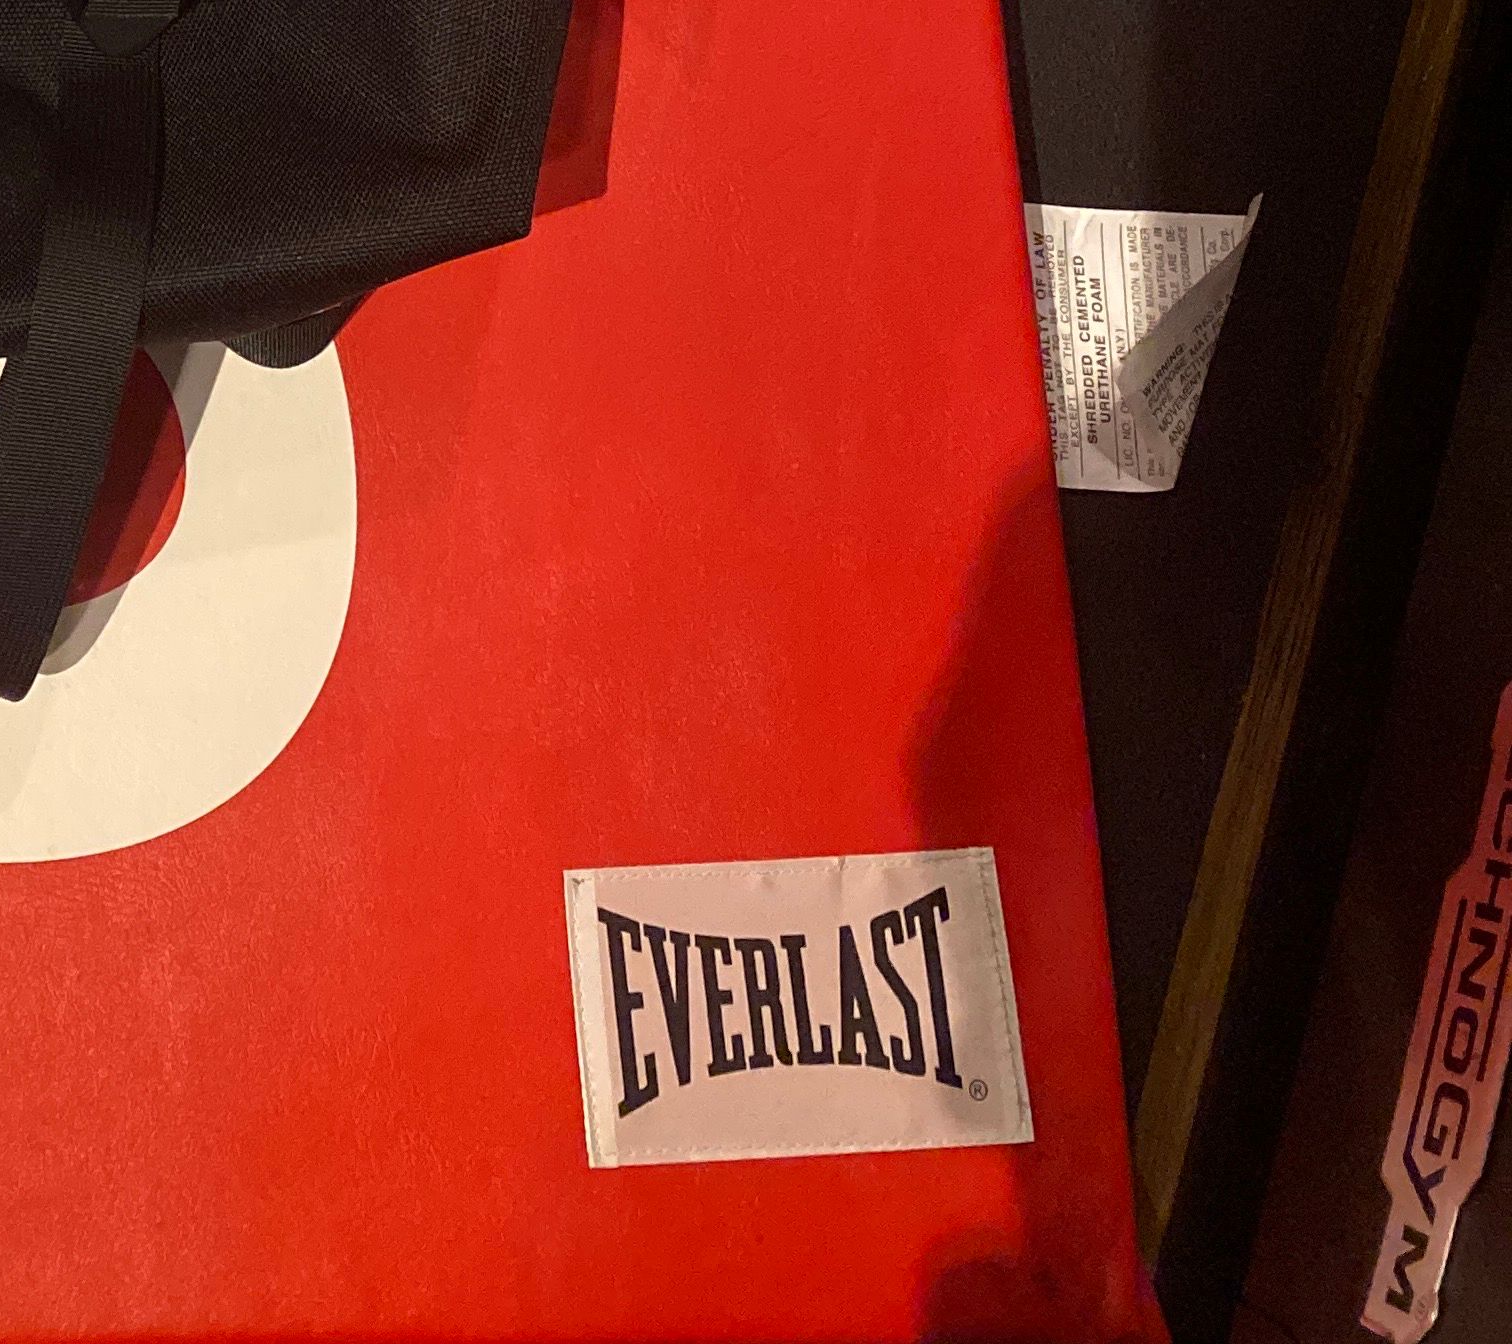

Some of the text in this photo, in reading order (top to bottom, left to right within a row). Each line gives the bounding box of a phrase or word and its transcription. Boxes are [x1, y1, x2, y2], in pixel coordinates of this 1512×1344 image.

[1033, 232, 1045, 269] LAW
[1127, 225, 1138, 253] MADE
[1129, 262, 1139, 272] IS
[1140, 227, 1154, 307] MANUFACTURER
[1154, 243, 1167, 298] MATERIALS
[1167, 253, 1178, 273] ARE
[1035, 278, 1046, 300] OF
[1038, 314, 1054, 392] PENALTY
[1051, 334, 1059, 352] TO
[1057, 249, 1079, 448] EXCEPT BY THE CONSUMER
[1072, 255, 1098, 444] SHREDDED CEMENTED
[1089, 278, 1111, 423] URETHANE FOAM
[1057, 395, 1066, 422] TAG
[1058, 432, 1068, 461] THIS
[596, 885, 963, 1119] EVERLAST
